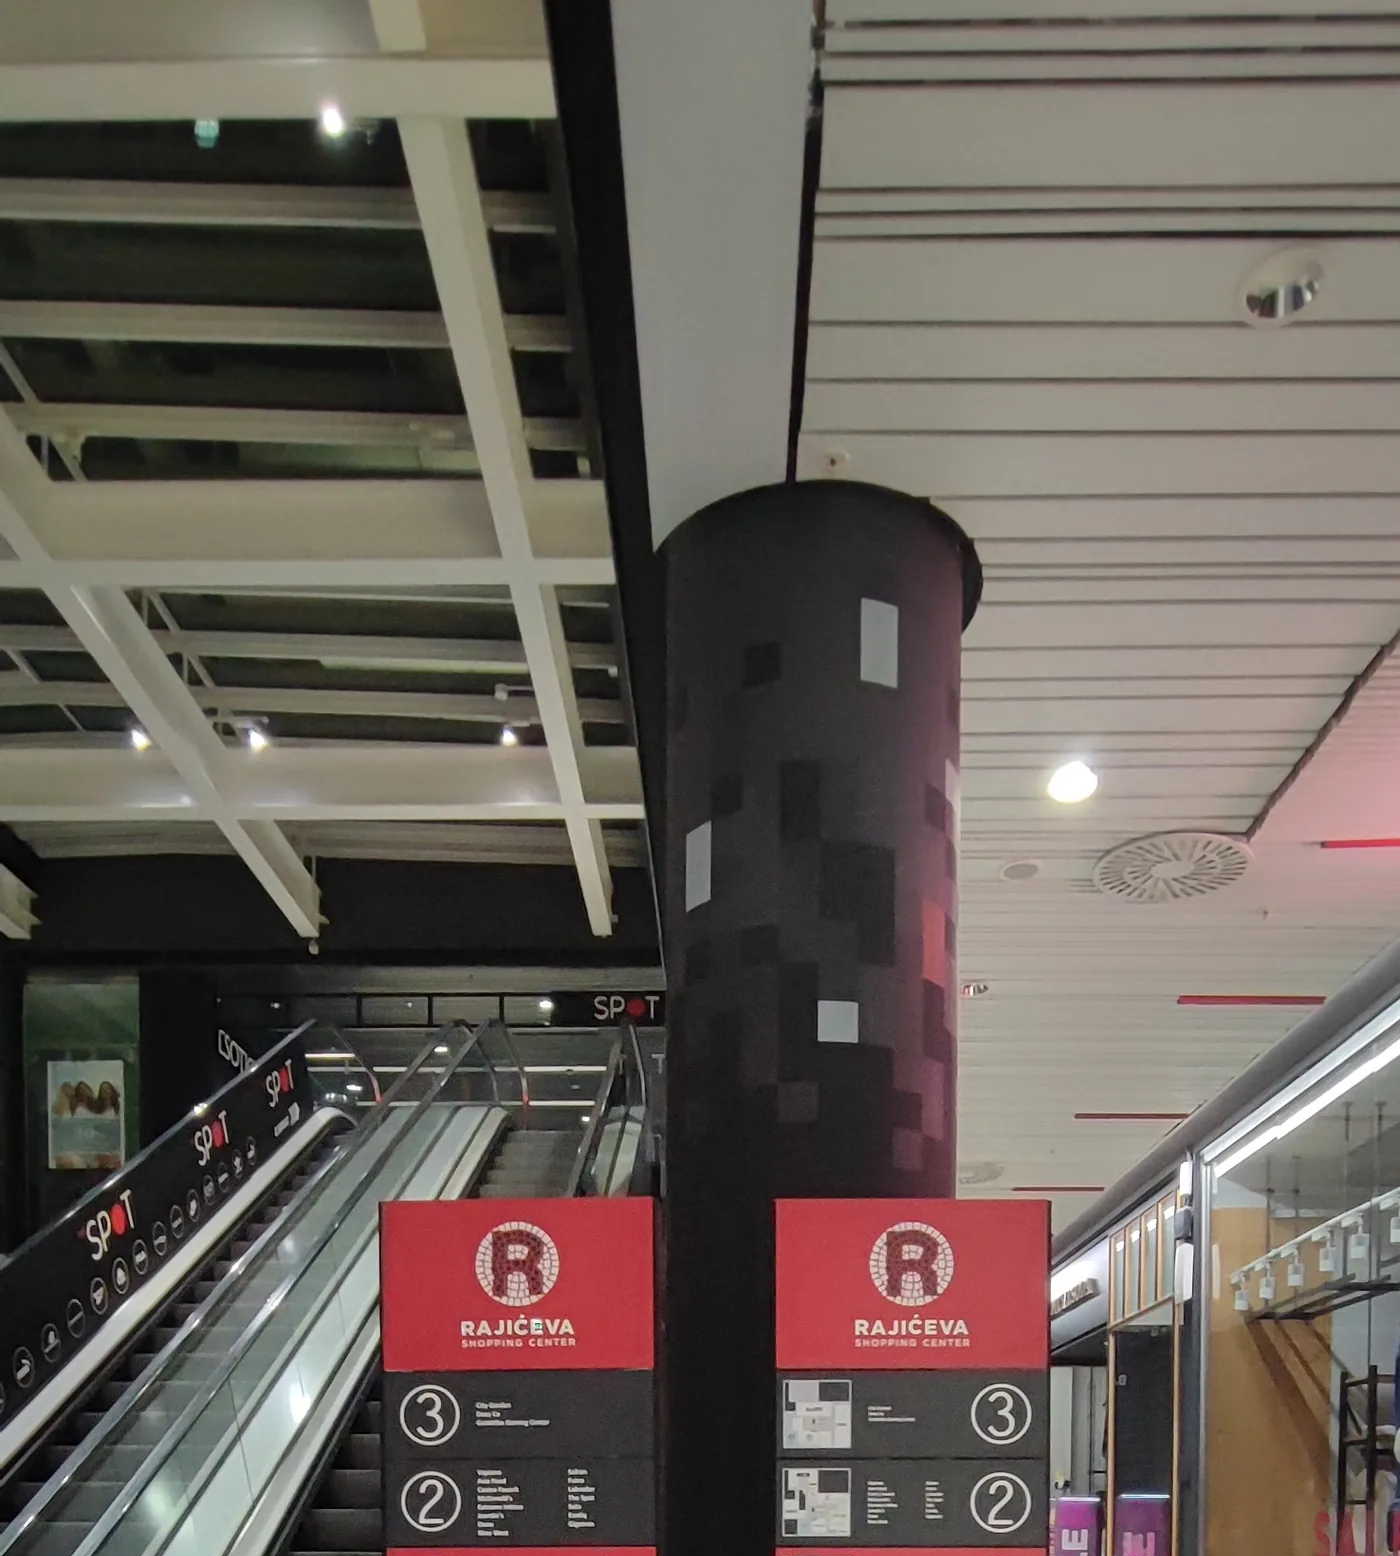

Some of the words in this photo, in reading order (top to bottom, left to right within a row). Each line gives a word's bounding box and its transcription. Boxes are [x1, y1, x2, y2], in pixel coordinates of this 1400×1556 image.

[594, 995, 660, 1020] SPOT
[265, 1058, 294, 1108] SPOT
[194, 1110, 230, 1167] SPOT
[85, 1188, 137, 1262] SPOT
[461, 1338, 523, 1348] SHOPPING
[528, 1337, 576, 1347] CENTER
[854, 1313, 969, 1335] RAJIĆEVA
[855, 1338, 917, 1347] SHOPPING
[922, 1338, 970, 1347] CENTER
[415, 1392, 444, 1438] 3
[987, 1391, 1015, 1437] 3
[418, 1478, 444, 1524] 2
[988, 1480, 1014, 1525] 2
